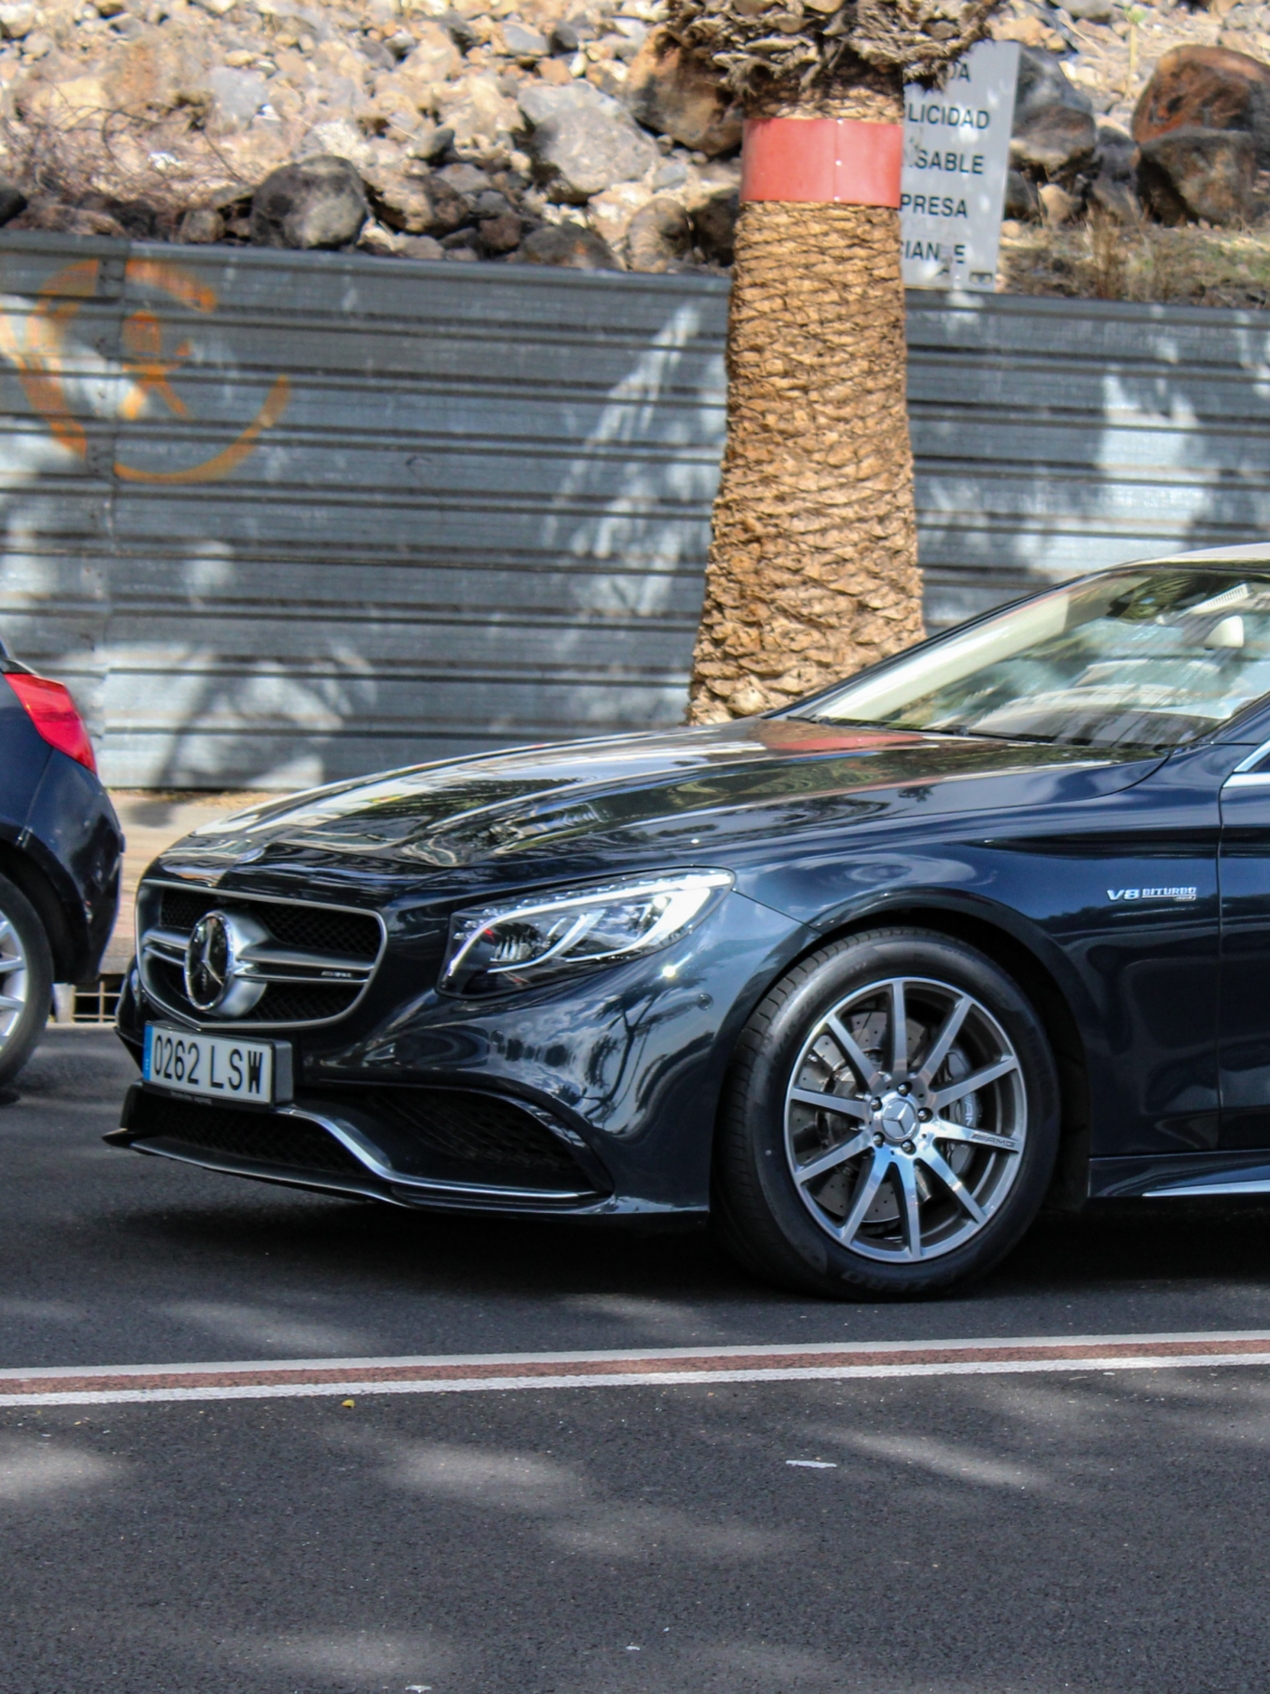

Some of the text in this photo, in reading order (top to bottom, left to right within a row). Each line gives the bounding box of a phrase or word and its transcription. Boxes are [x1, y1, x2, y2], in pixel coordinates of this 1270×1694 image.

[908, 103, 990, 129] LICIDAD
[915, 149, 985, 175] SABLE
[899, 193, 967, 218] PRESA
[1107, 889, 1140, 901] V8
[154, 1035, 263, 1094] 0262 LSW
